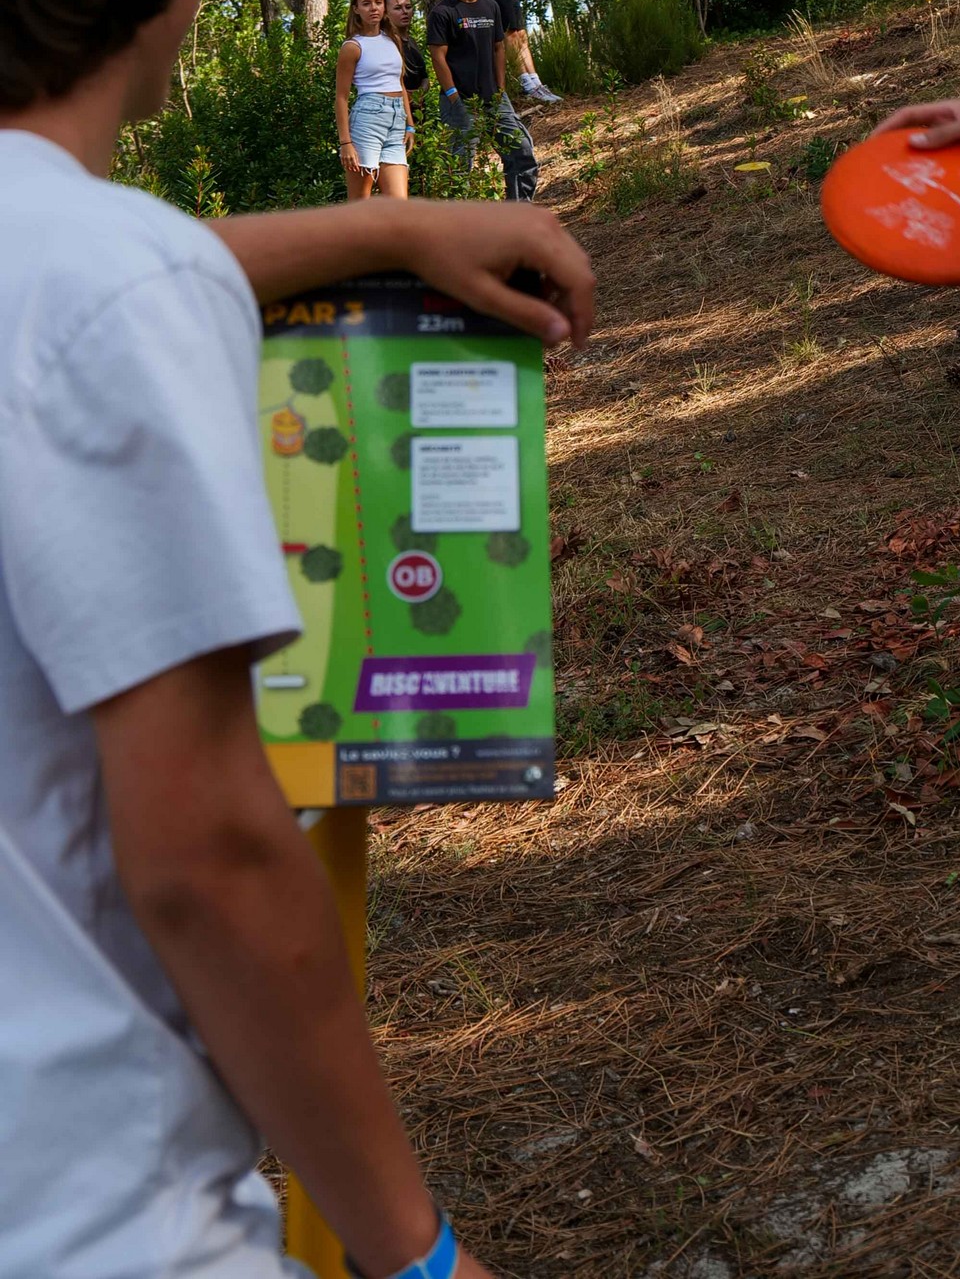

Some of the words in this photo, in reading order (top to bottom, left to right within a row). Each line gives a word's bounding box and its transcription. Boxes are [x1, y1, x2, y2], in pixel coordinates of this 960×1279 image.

[265, 301, 336, 326] PAR
[343, 300, 365, 326] 3
[395, 565, 433, 588] OB
